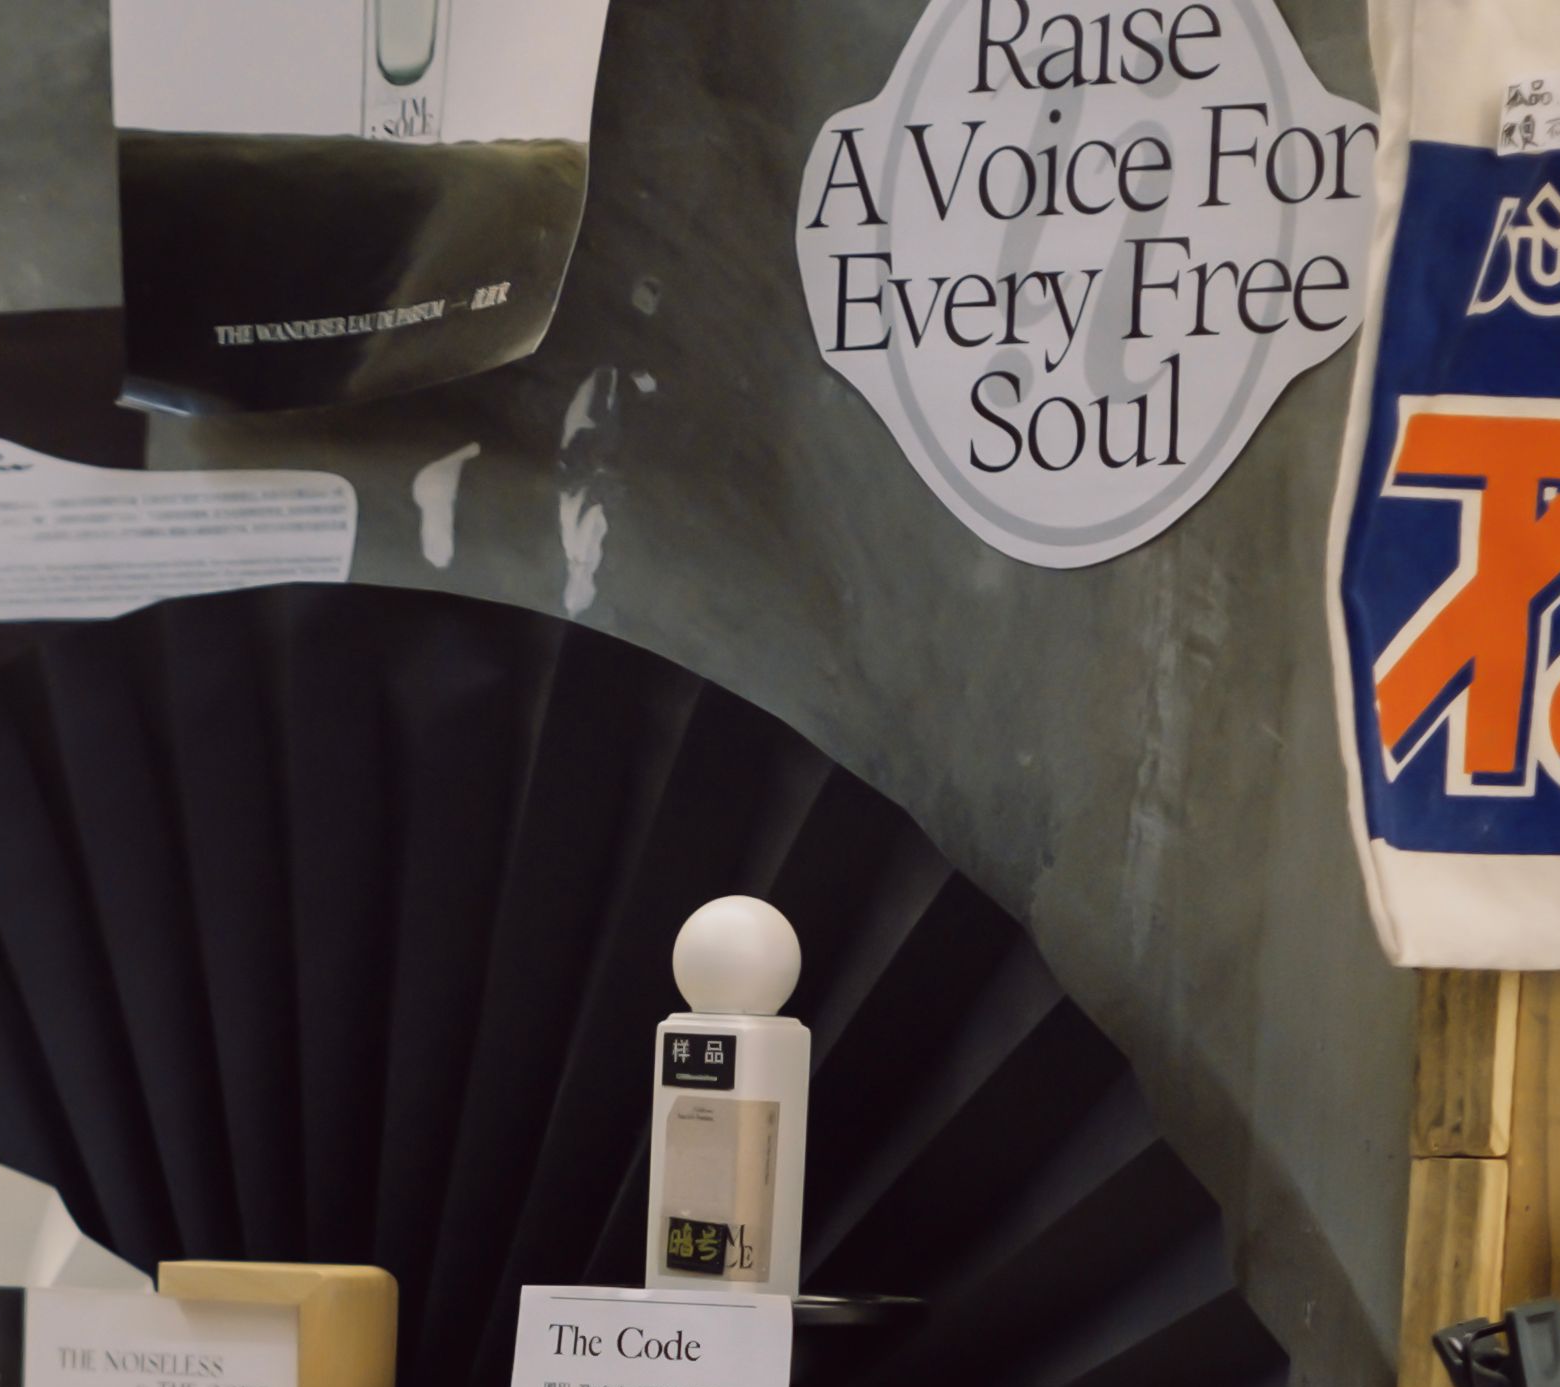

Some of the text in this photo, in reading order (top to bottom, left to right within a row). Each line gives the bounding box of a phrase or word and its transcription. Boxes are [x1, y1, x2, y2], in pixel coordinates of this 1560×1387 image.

[969, 0, 1221, 93] Raise
[805, 102, 1379, 229] A Voice For
[825, 236, 1350, 374] Every Free
[969, 354, 1187, 473] Soul
[672, 1039, 724, 1064] 样品
[58, 1347, 224, 1378] THE NOISELESS
[549, 1323, 701, 1362] The Code
